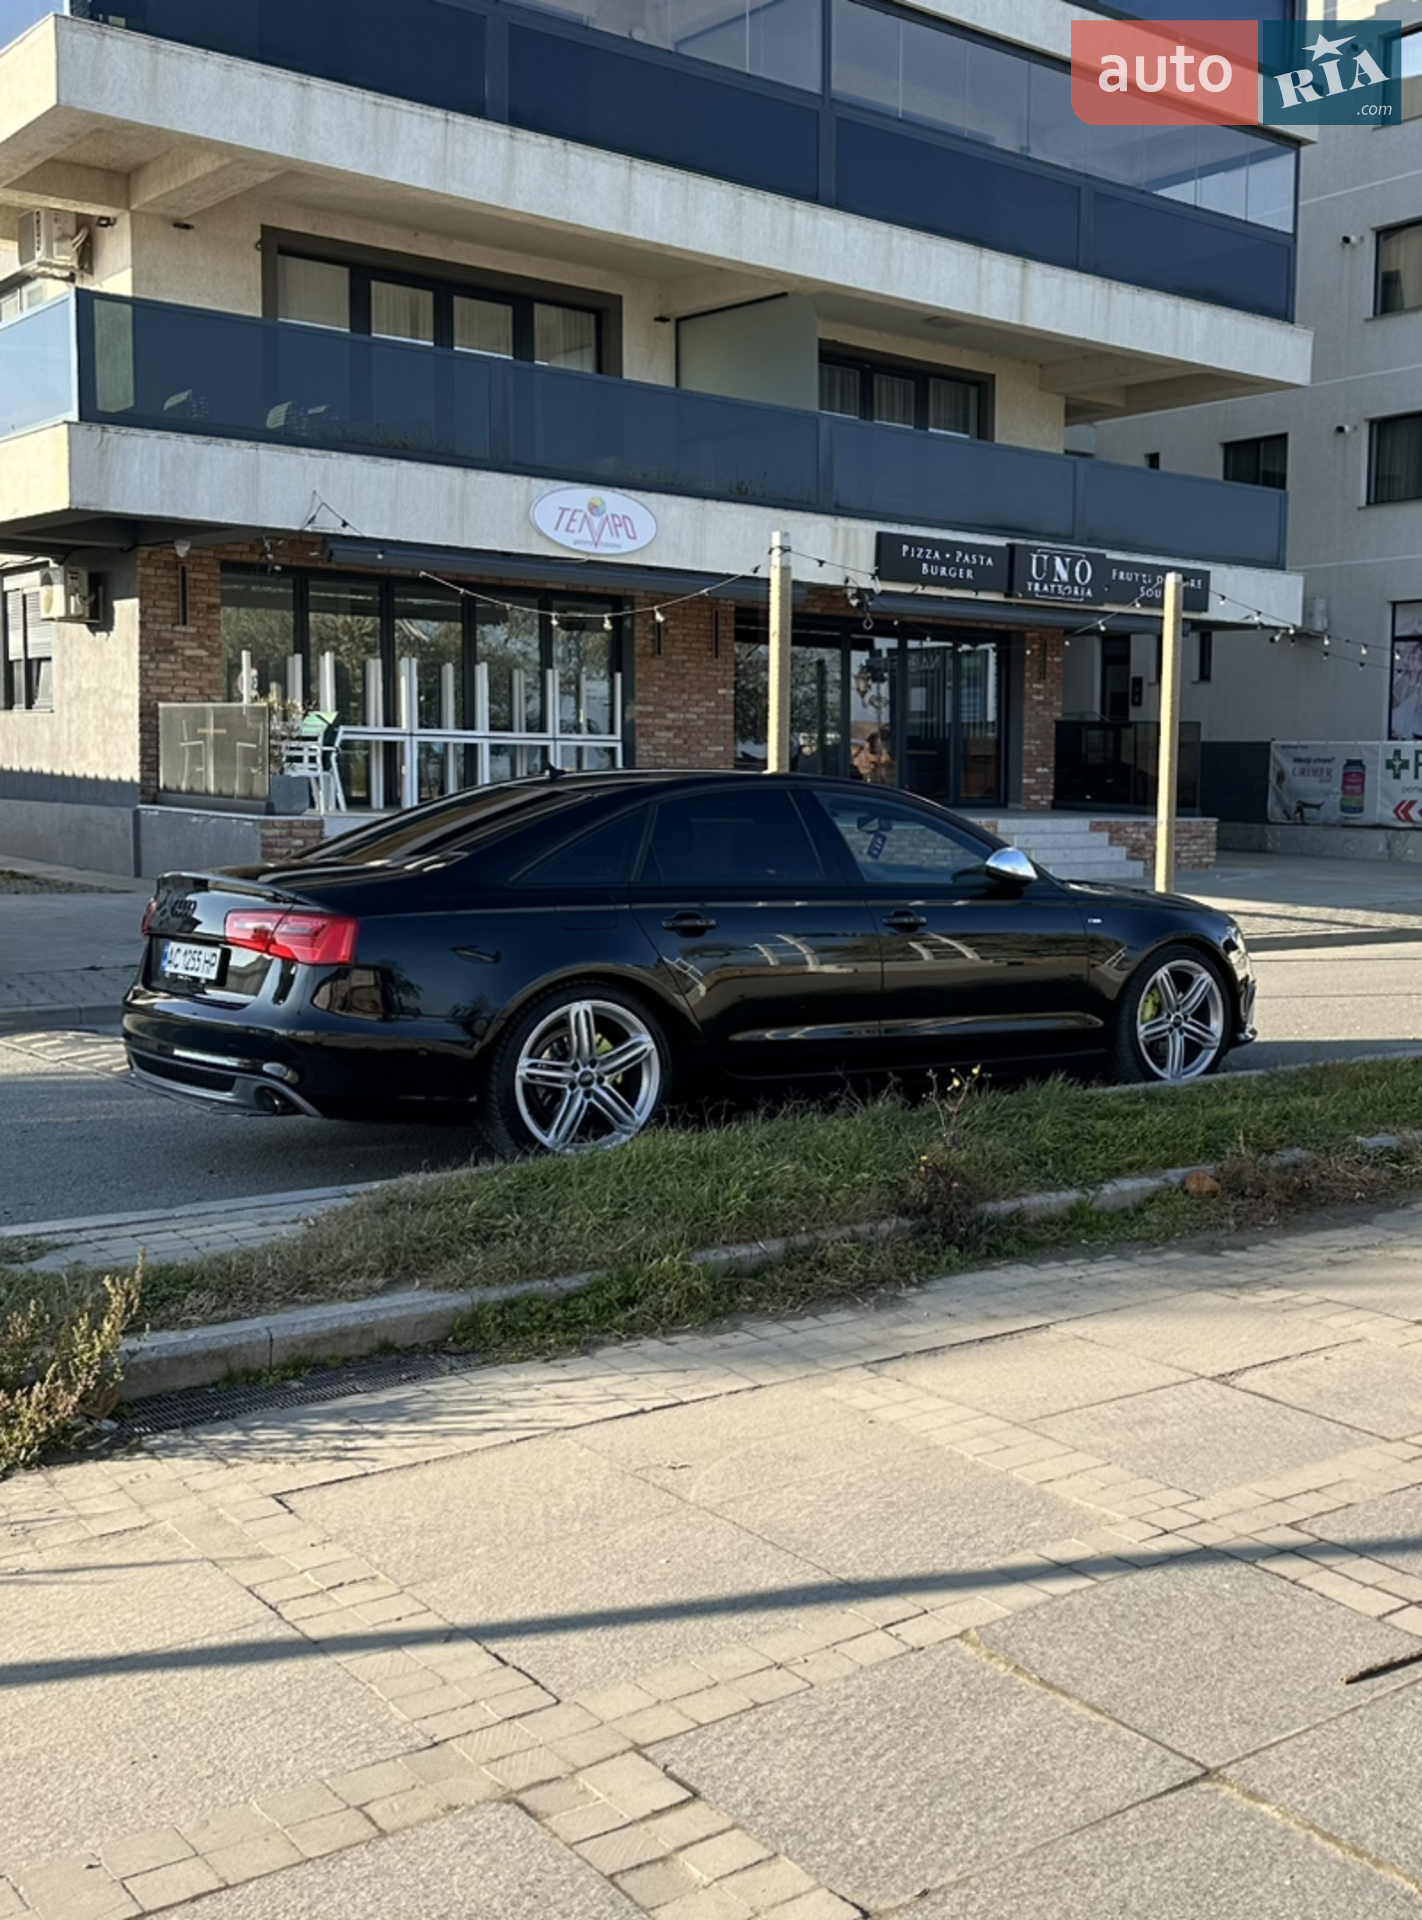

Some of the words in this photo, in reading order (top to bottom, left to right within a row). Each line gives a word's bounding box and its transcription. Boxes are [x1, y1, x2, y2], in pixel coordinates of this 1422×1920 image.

[554, 506, 638, 548] TEMPO
[902, 544, 940, 560] PIZZA
[956, 551, 994, 566] PASTA
[922, 563, 974, 579] BURGER
[1030, 553, 1092, 585] UNO
[1026, 581, 1093, 598] TRATTORIA
